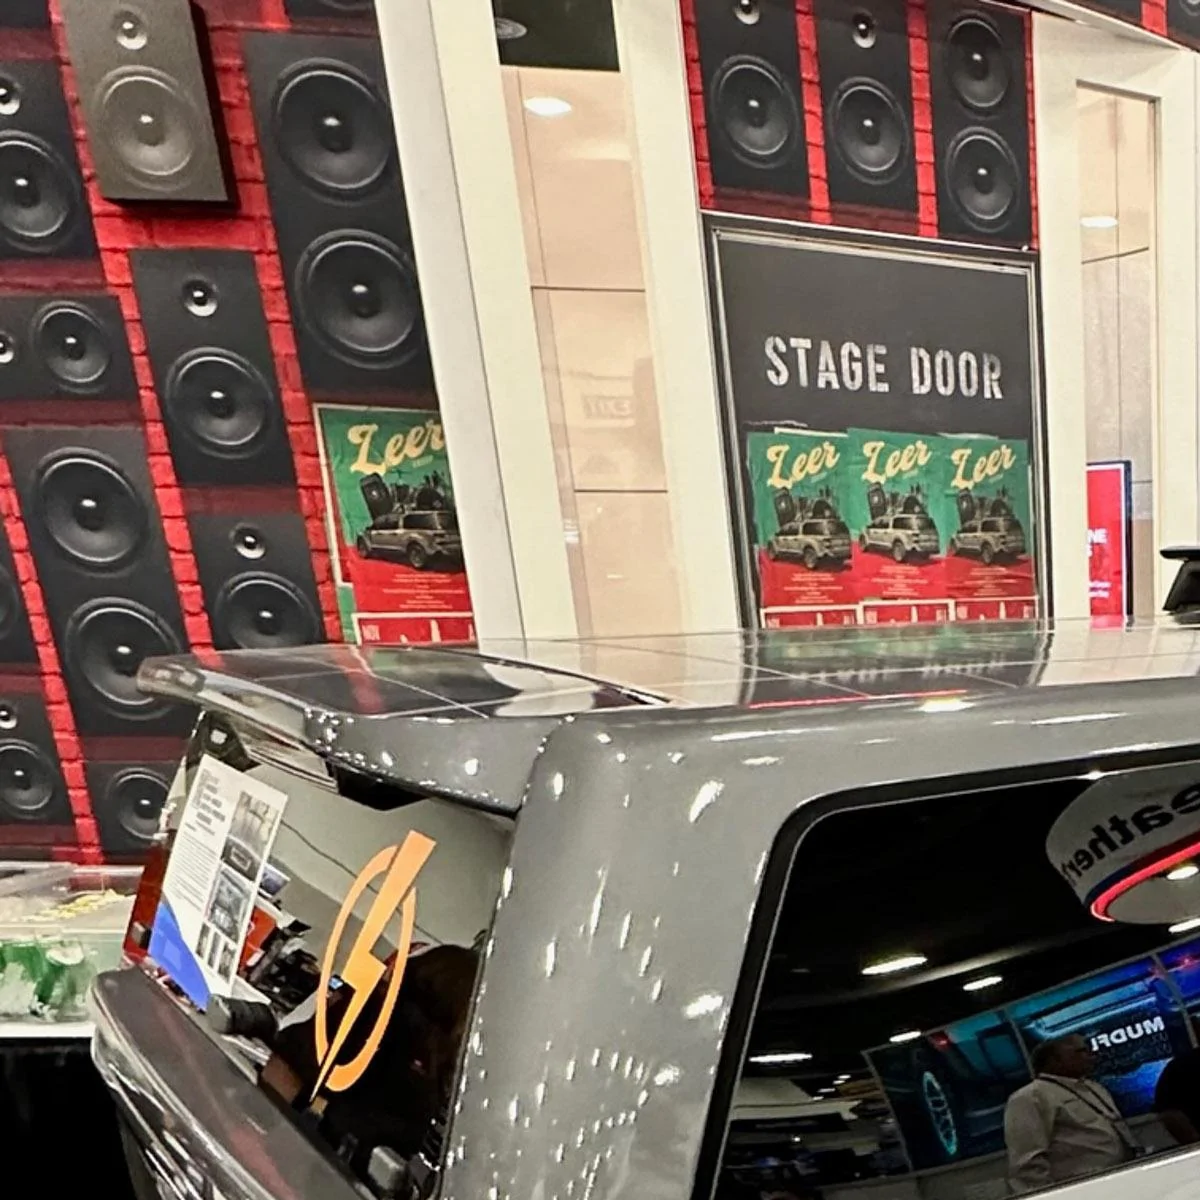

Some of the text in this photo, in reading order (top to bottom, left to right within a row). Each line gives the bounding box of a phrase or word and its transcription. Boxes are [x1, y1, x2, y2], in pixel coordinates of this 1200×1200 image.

[764, 335, 1003, 399] STAGE DOOR
[348, 420, 446, 476] Leer
[767, 440, 840, 489] Leer
[862, 440, 932, 485] Leer
[950, 444, 1017, 490] Leer
